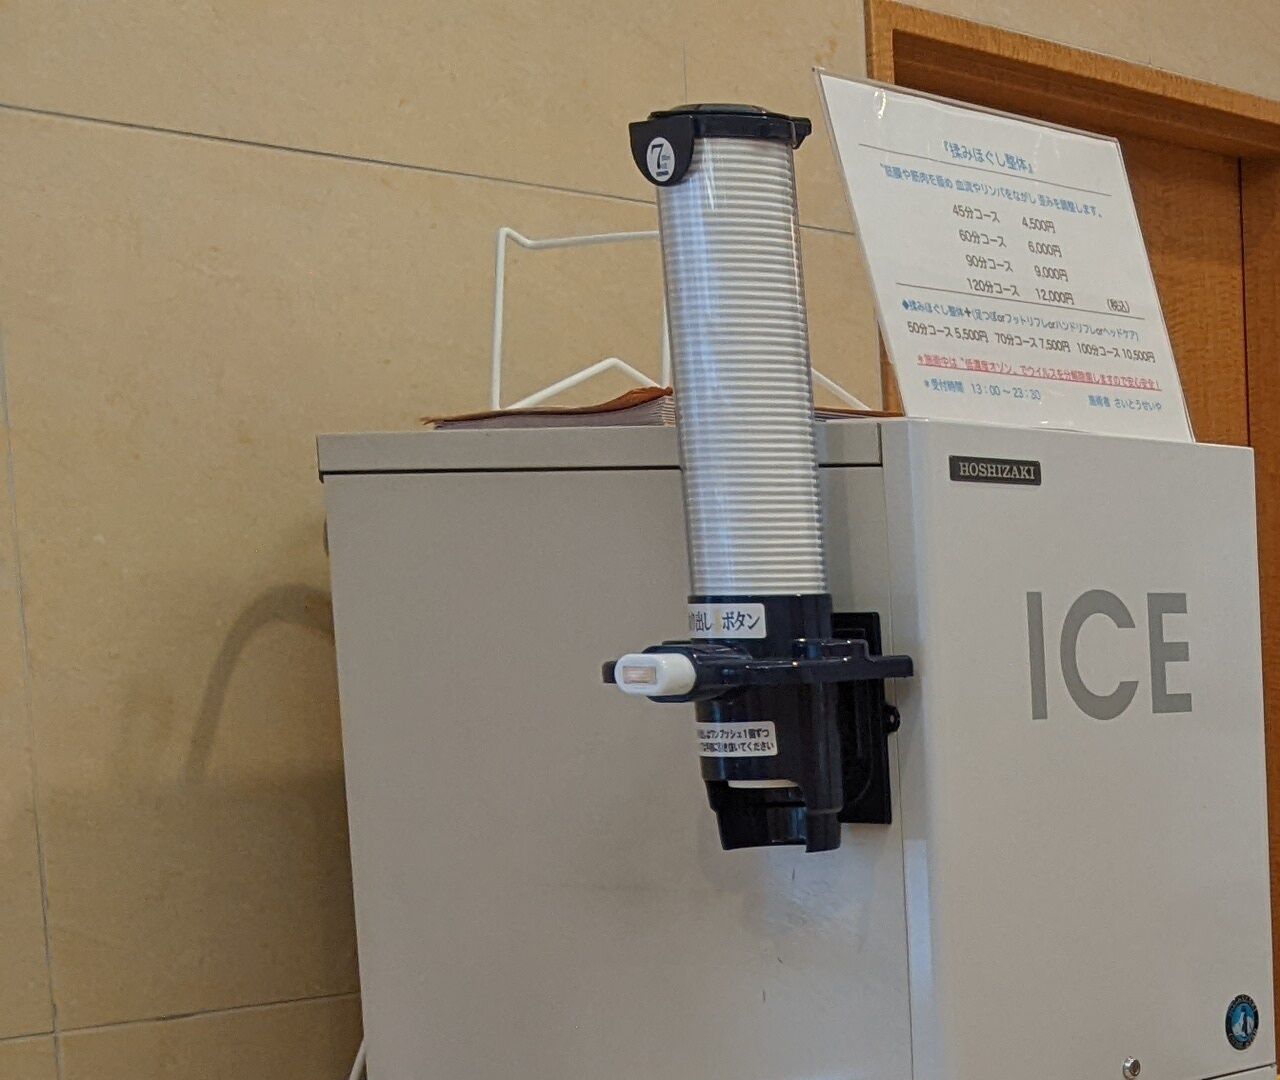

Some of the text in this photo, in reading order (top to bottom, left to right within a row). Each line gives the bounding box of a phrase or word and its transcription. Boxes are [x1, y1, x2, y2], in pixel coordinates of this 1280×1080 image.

[958, 461, 1036, 481] HOSHIZAKI
[721, 610, 761, 632] ボタン
[1026, 589, 1193, 721] ICE
